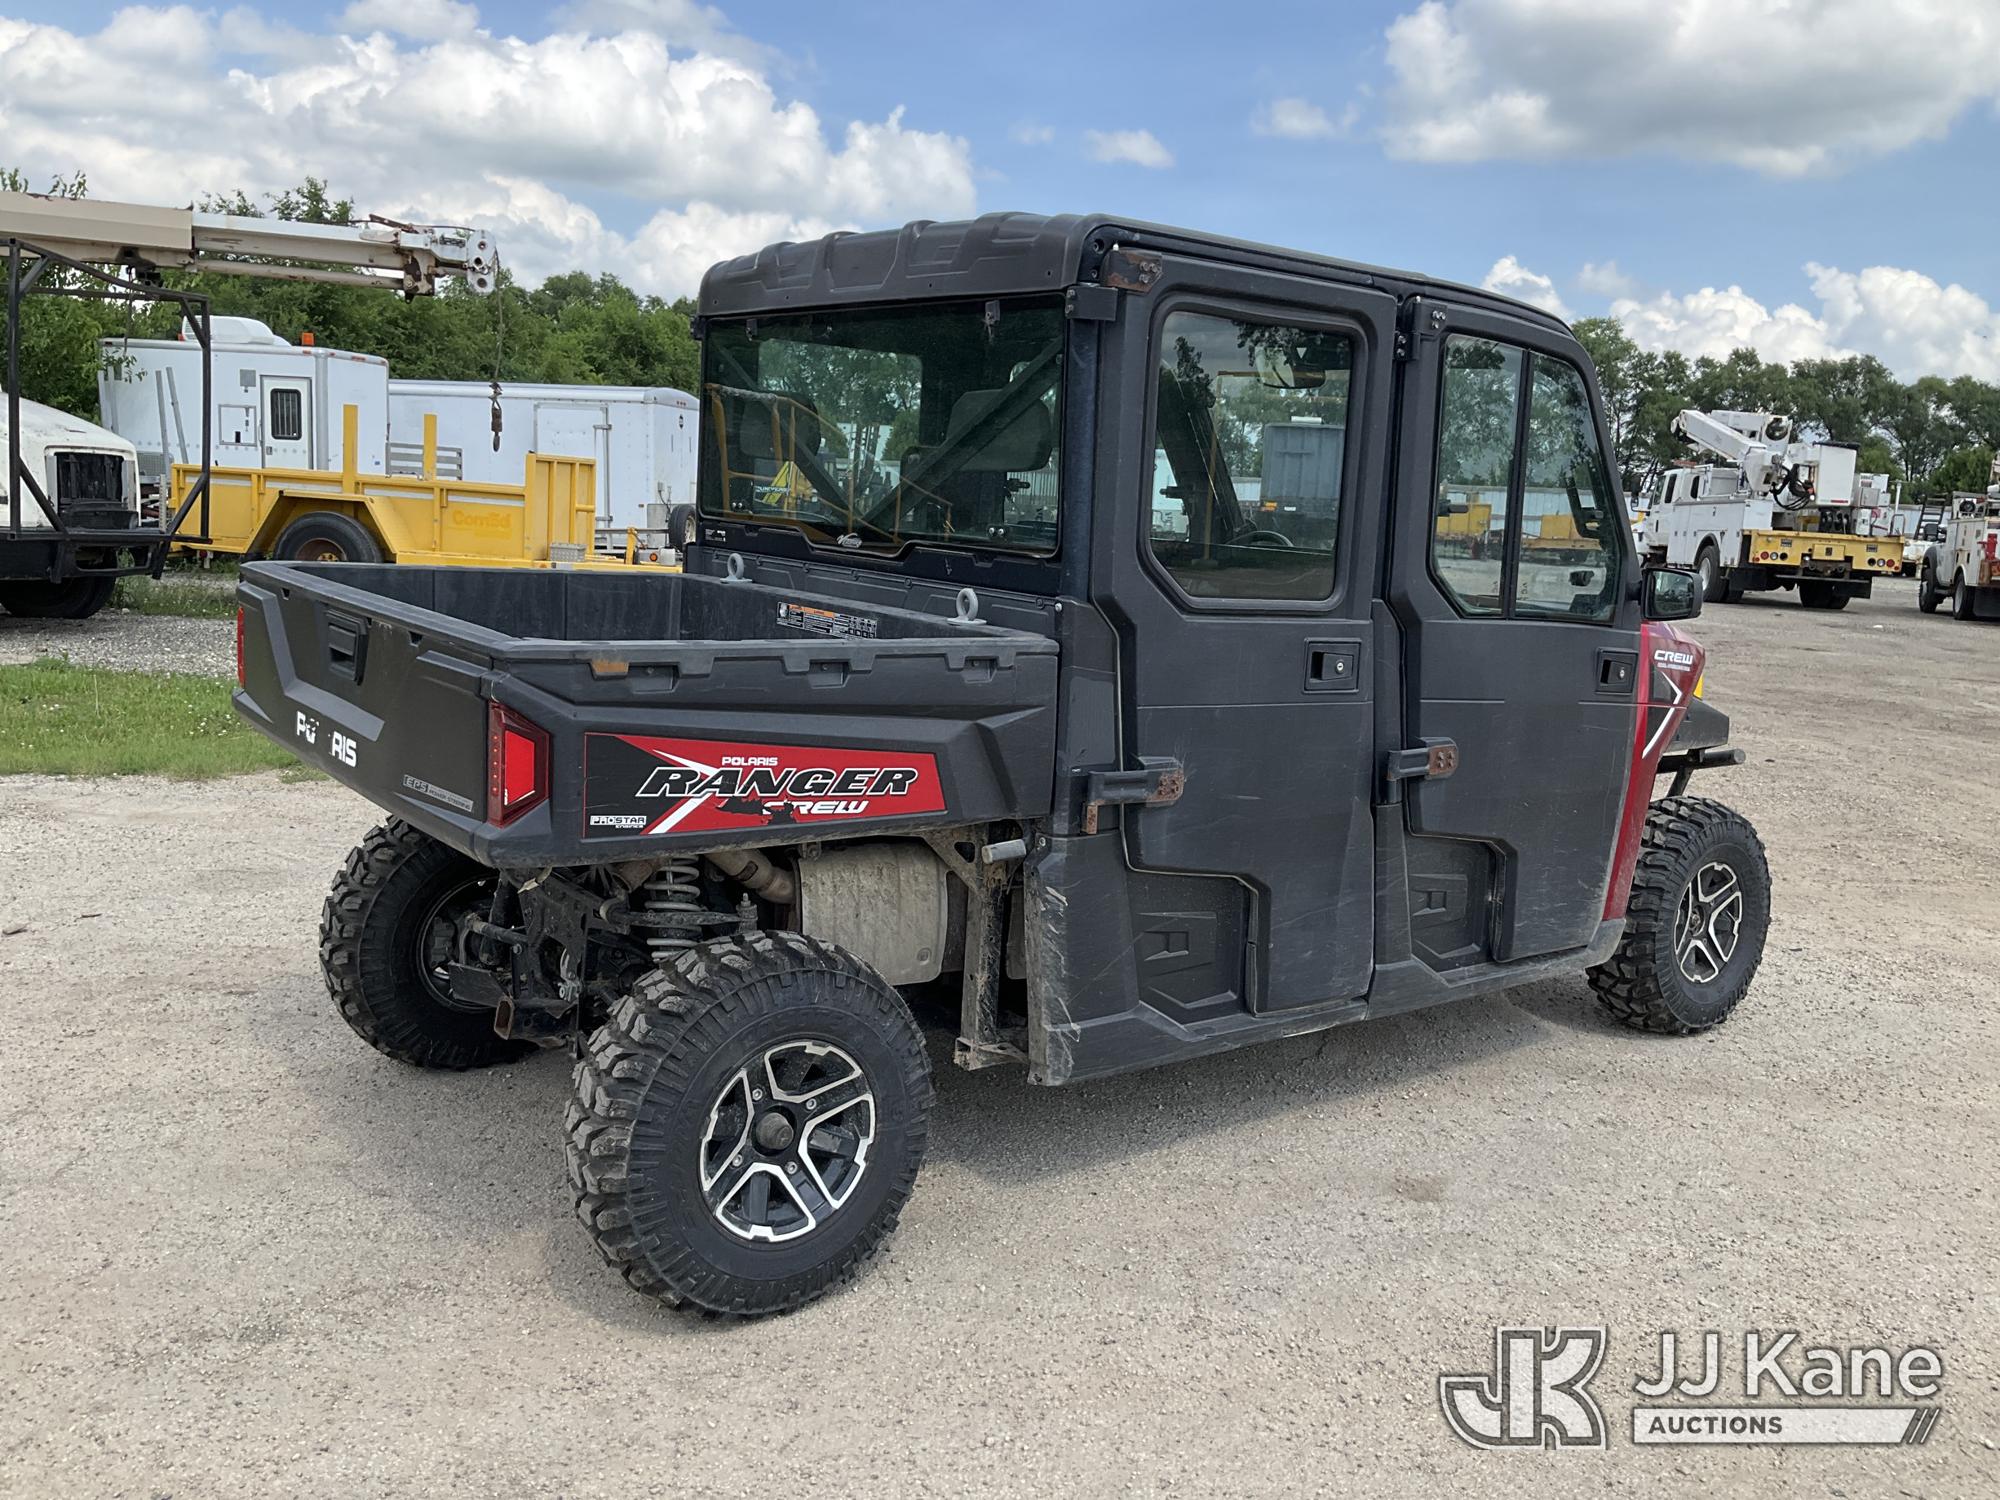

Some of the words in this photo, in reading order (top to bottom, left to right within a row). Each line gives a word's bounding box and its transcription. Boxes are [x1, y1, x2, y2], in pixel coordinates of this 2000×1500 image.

[1654, 650, 1693, 665] CREW
[722, 757, 778, 766] POLARIS
[404, 777, 429, 793] EPS
[635, 767, 918, 798] RANGER
